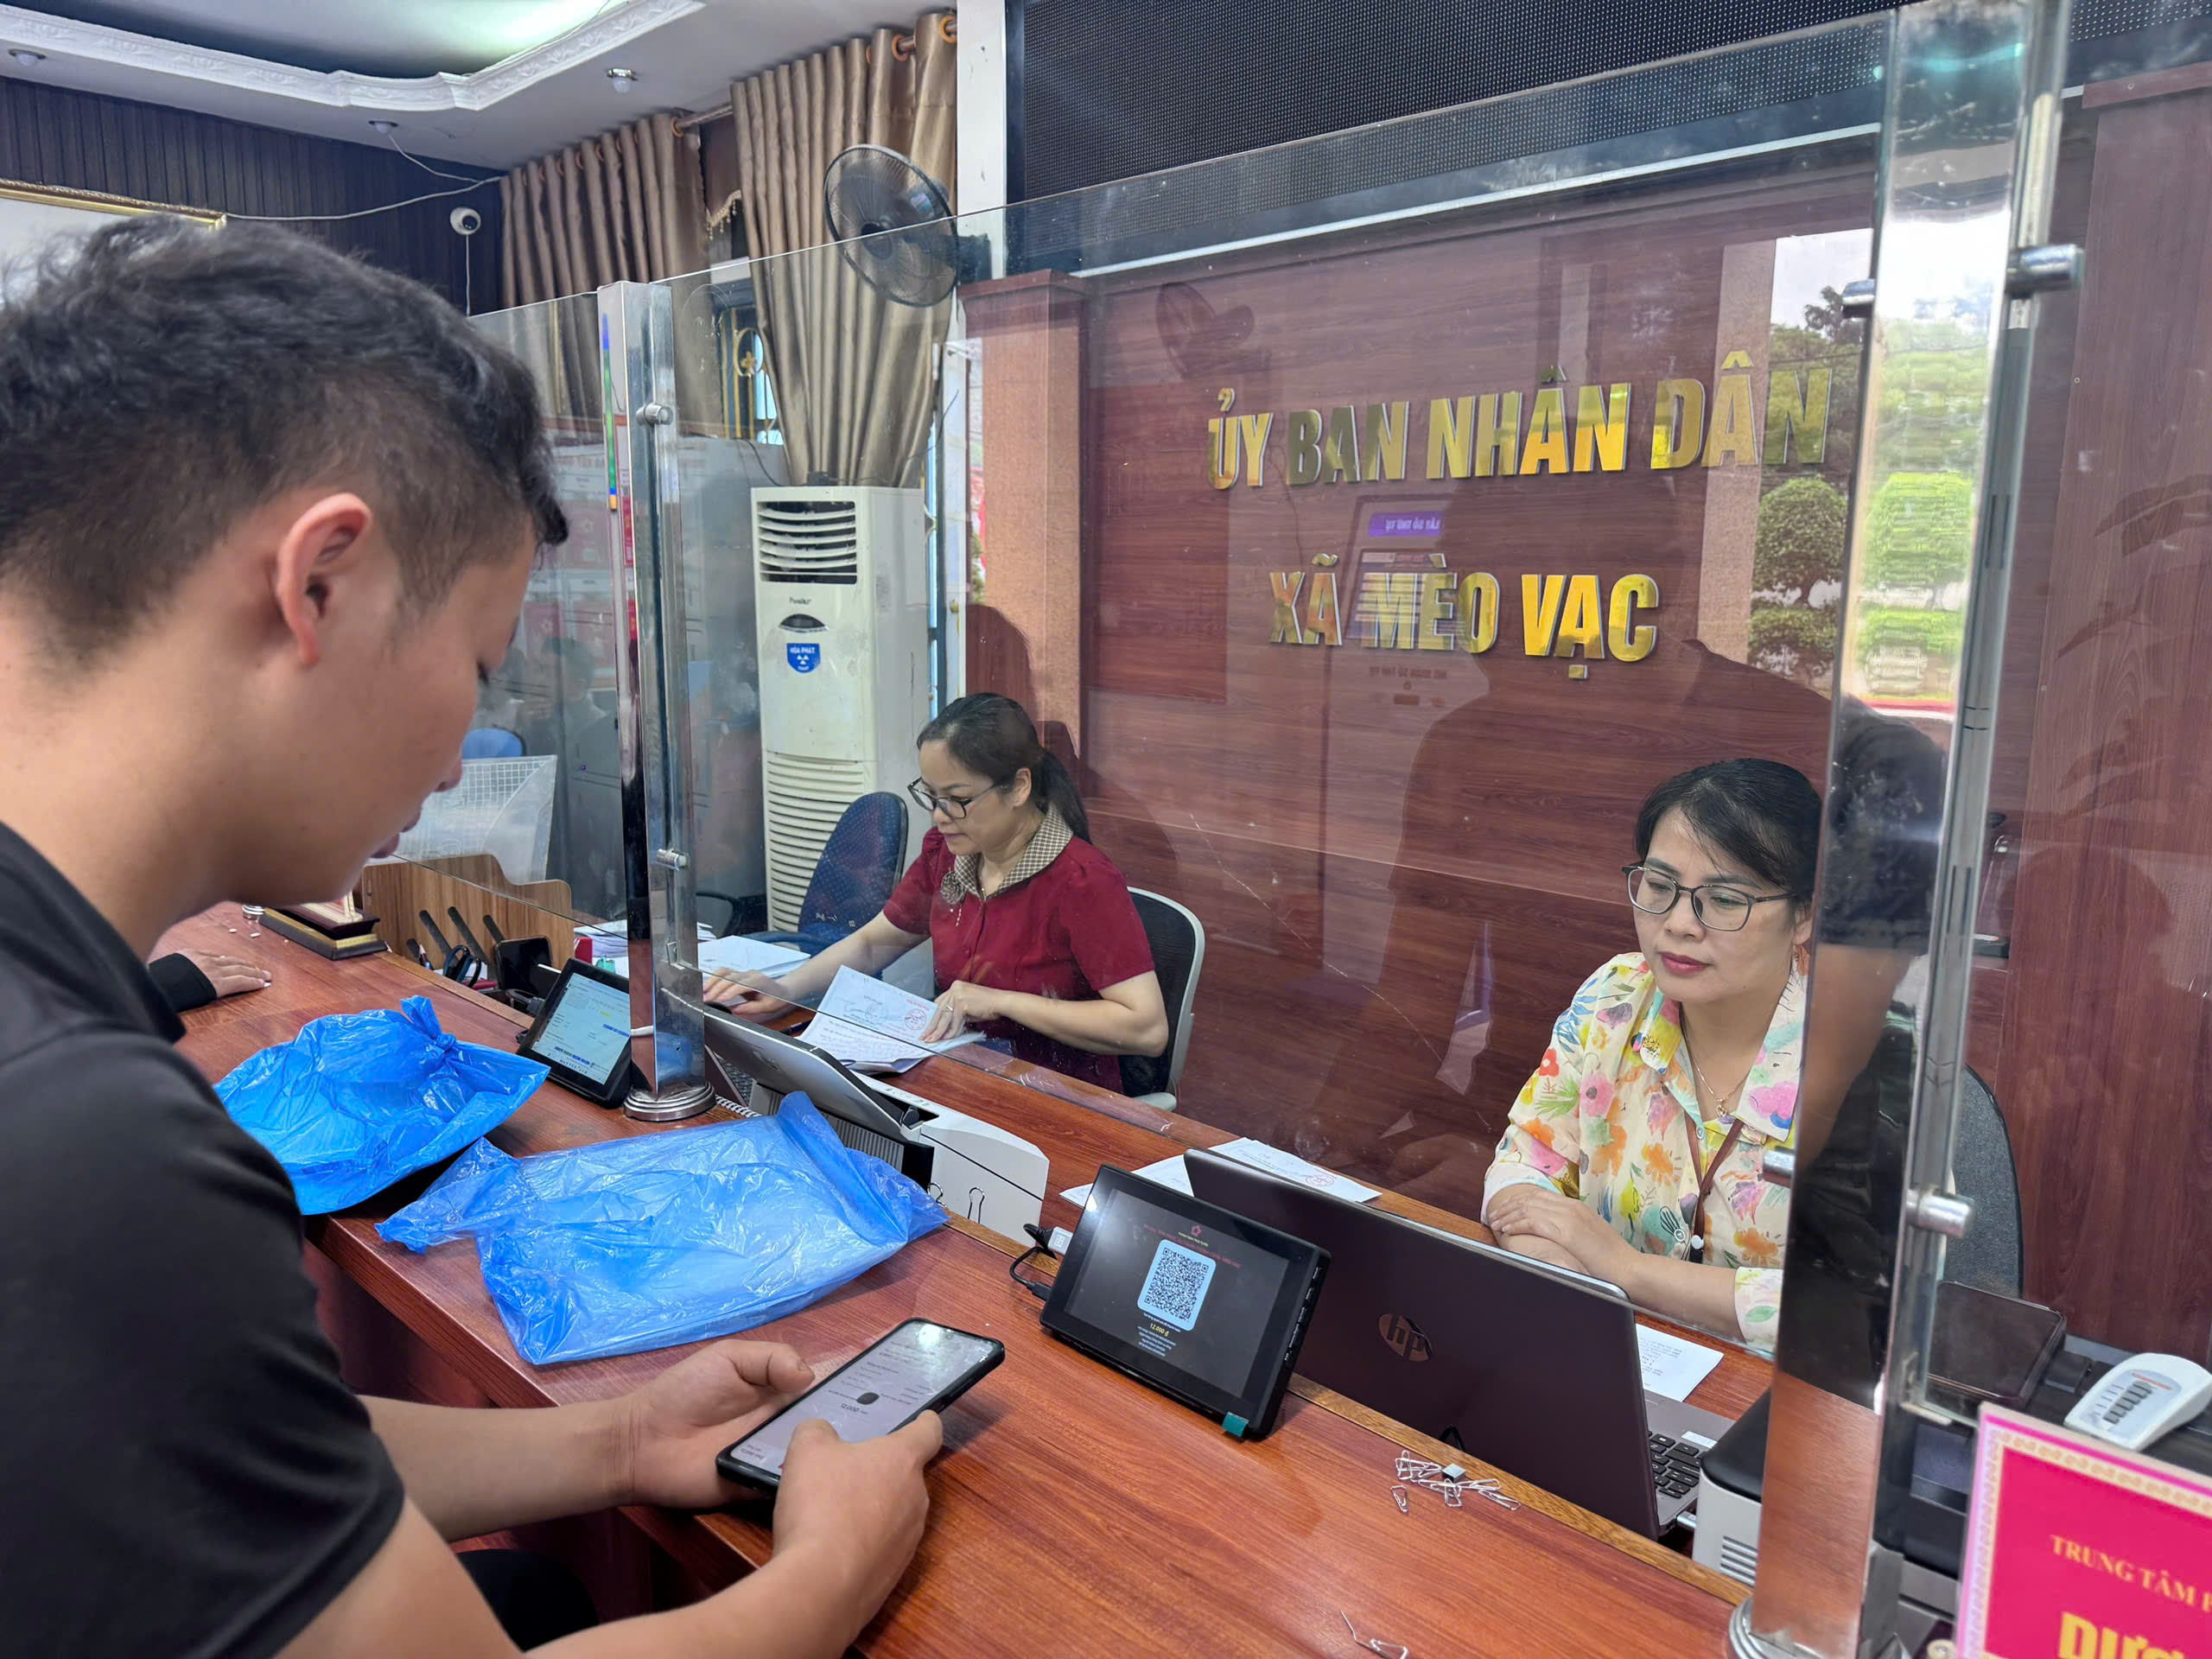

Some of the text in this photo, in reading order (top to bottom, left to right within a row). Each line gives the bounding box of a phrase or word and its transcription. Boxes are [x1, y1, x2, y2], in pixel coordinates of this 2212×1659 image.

[1207, 349, 1834, 491] ỦY BAN NHÂN DÂN
[1268, 552, 1659, 680] XÃ MÈO VẠC
[1378, 1313, 1431, 1362] hp
[2050, 1534, 2135, 1583] TRUNG
[2139, 1567, 2196, 1608] TÂM
